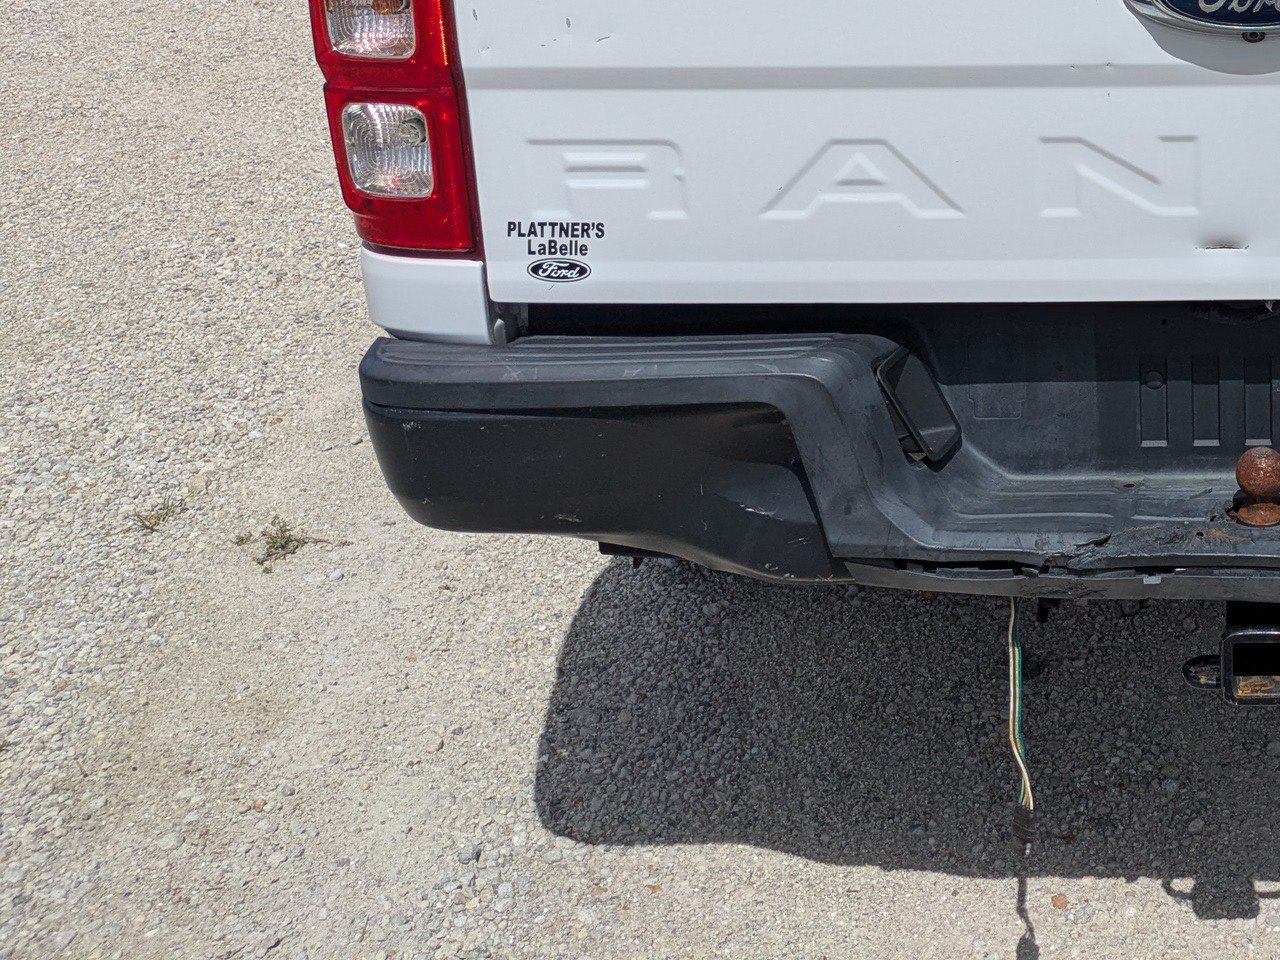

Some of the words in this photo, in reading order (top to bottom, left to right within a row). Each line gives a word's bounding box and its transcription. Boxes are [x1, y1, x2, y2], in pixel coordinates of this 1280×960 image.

[507, 221, 605, 239] PLATTNER'S
[528, 239, 588, 256] LaBelle
[538, 261, 580, 278] Ford
